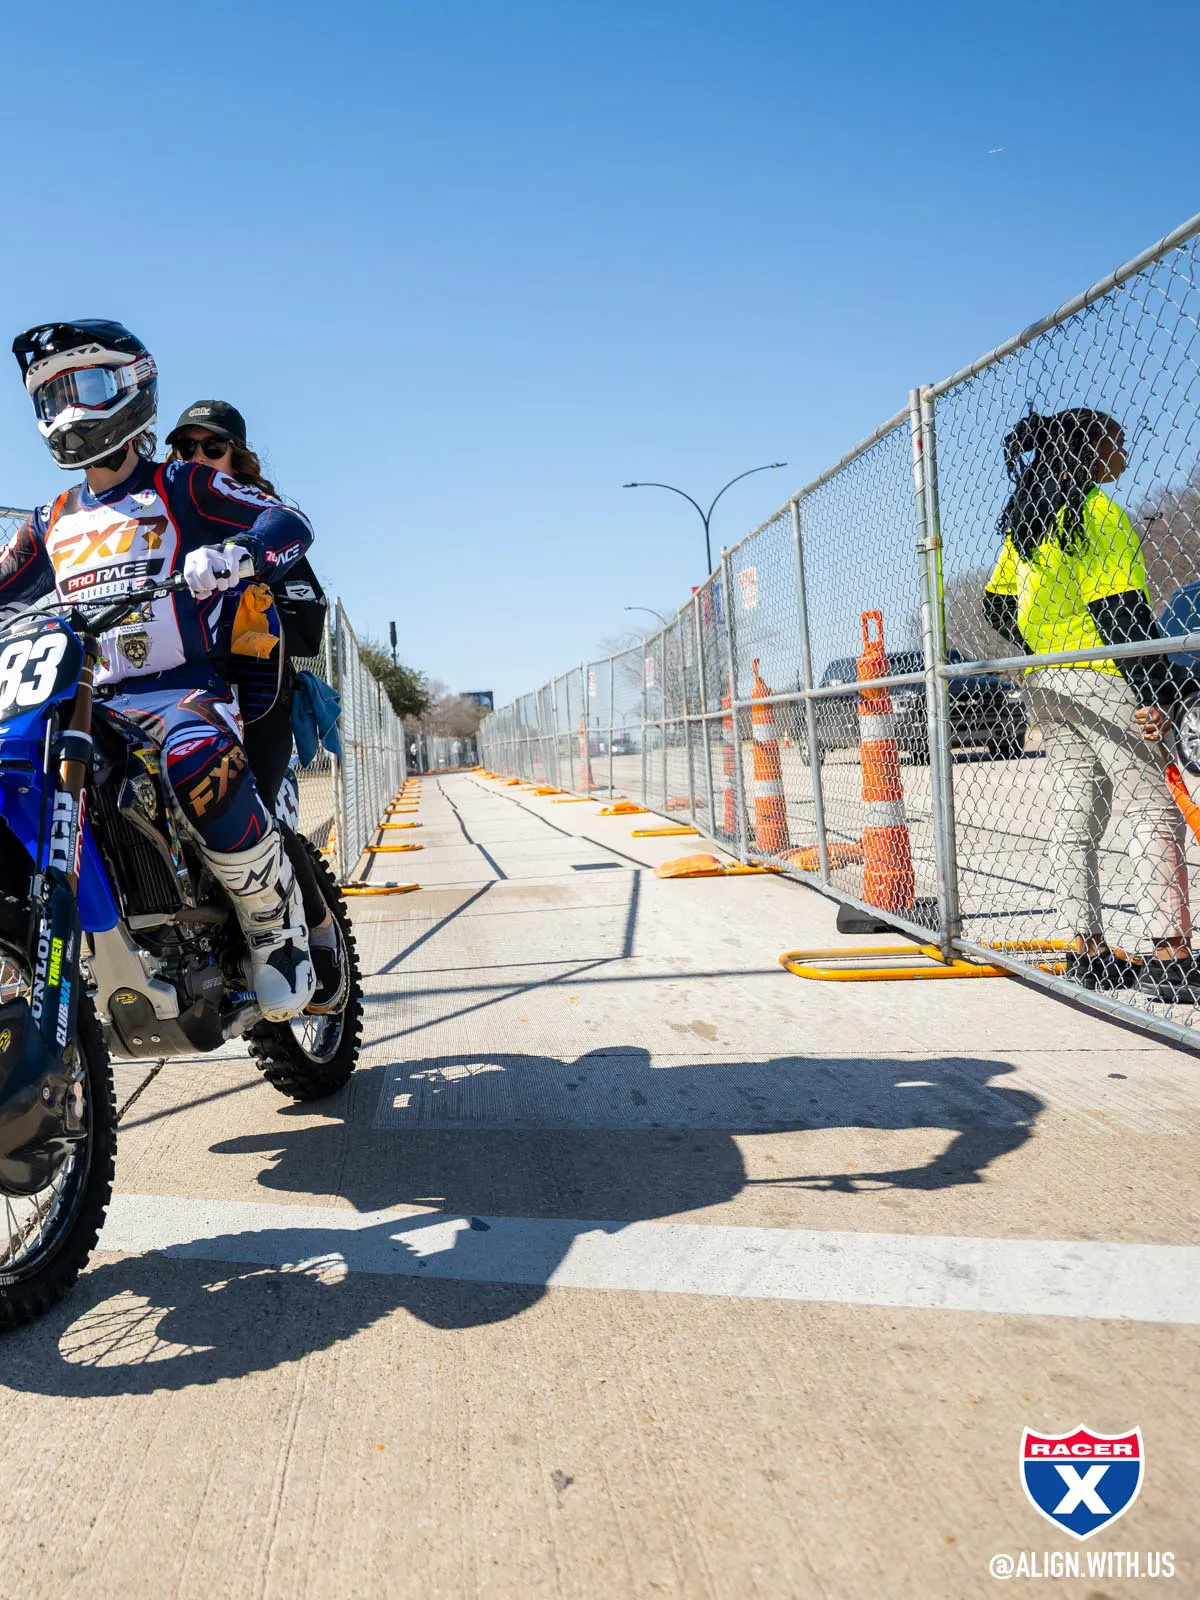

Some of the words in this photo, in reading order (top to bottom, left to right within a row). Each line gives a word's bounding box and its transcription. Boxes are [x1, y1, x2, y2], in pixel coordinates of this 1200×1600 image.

[51, 515, 169, 574] FXR
[67, 573, 97, 592] PRO
[96, 562, 148, 583] RACE
[189, 745, 248, 817] FXR
[56, 976, 71, 1049] CLUBMX
